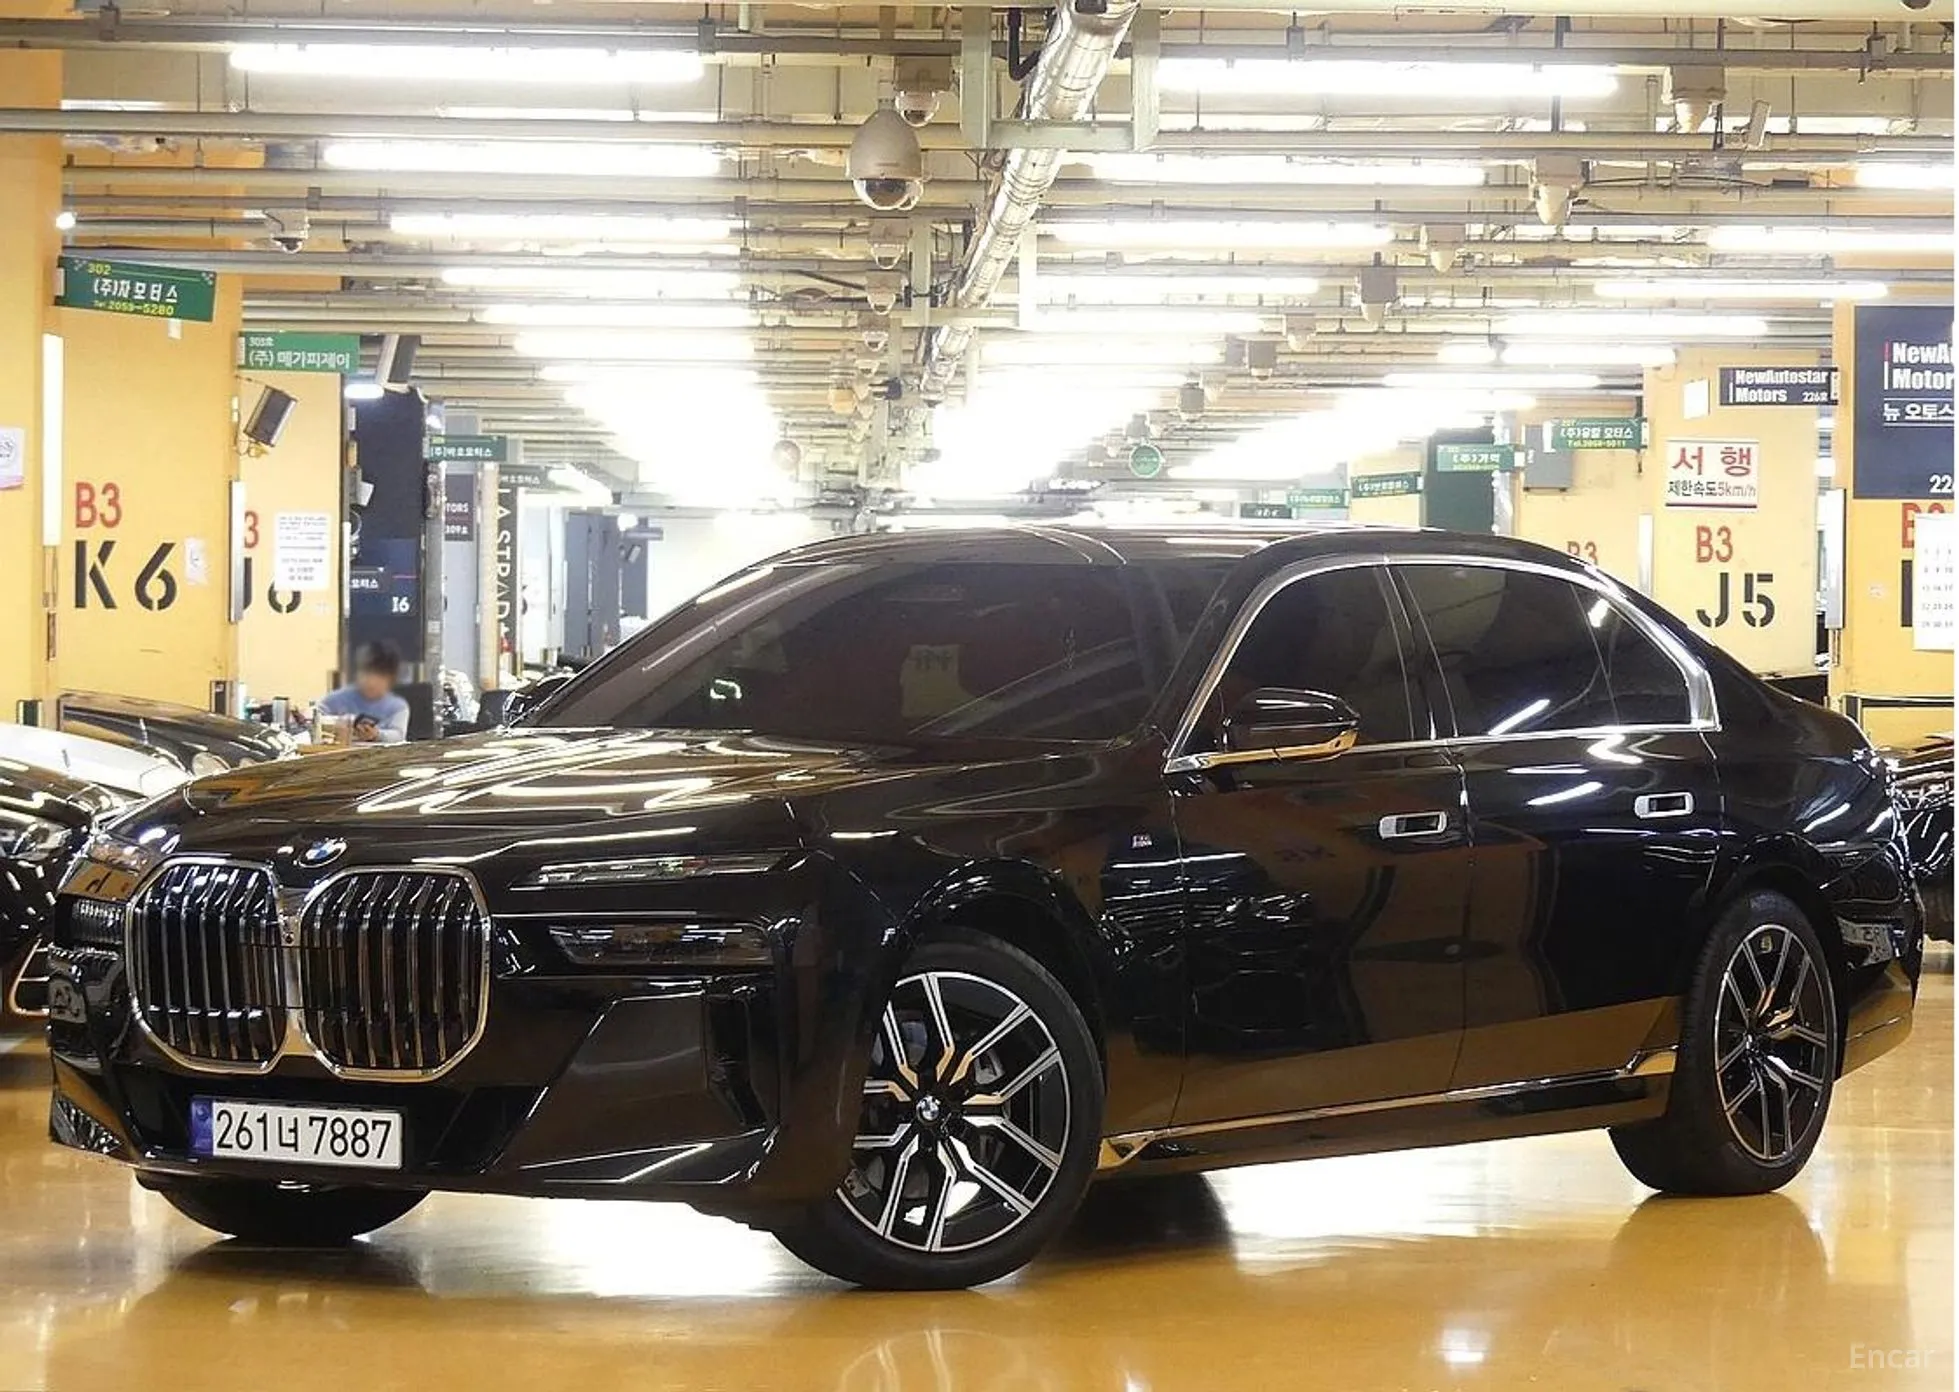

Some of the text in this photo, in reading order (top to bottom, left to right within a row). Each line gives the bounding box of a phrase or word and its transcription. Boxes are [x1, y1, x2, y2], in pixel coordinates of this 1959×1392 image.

[1735, 369, 1828, 385] NewAutostar
[1735, 387, 1788, 402] Motors
[1883, 403, 1900, 421] 뉴
[1929, 474, 1954, 493] 22
[75, 482, 122, 528] B3
[1695, 525, 1734, 563] B3
[216, 1109, 392, 1159] 261너 7887
